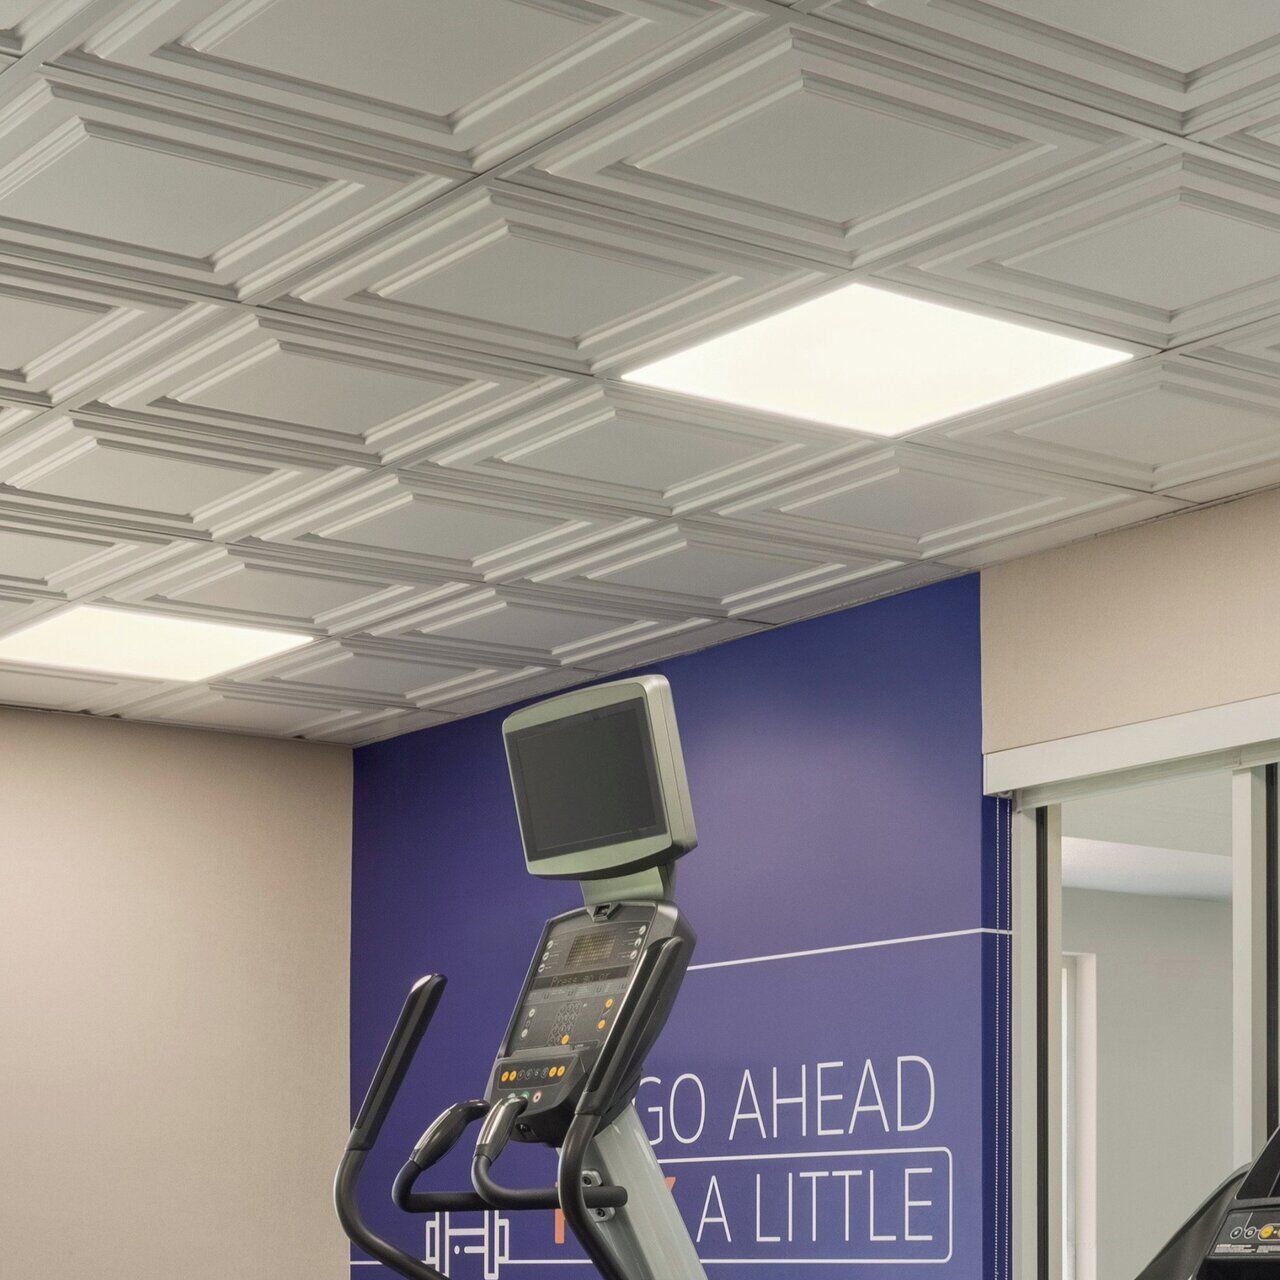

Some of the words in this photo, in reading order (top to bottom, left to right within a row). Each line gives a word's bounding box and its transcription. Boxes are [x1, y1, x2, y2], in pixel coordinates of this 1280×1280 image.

[632, 1073, 706, 1146] GO
[728, 1055, 935, 1141] AHEAD
[695, 1175, 732, 1243] A
[756, 1167, 933, 1242] LITTLE
